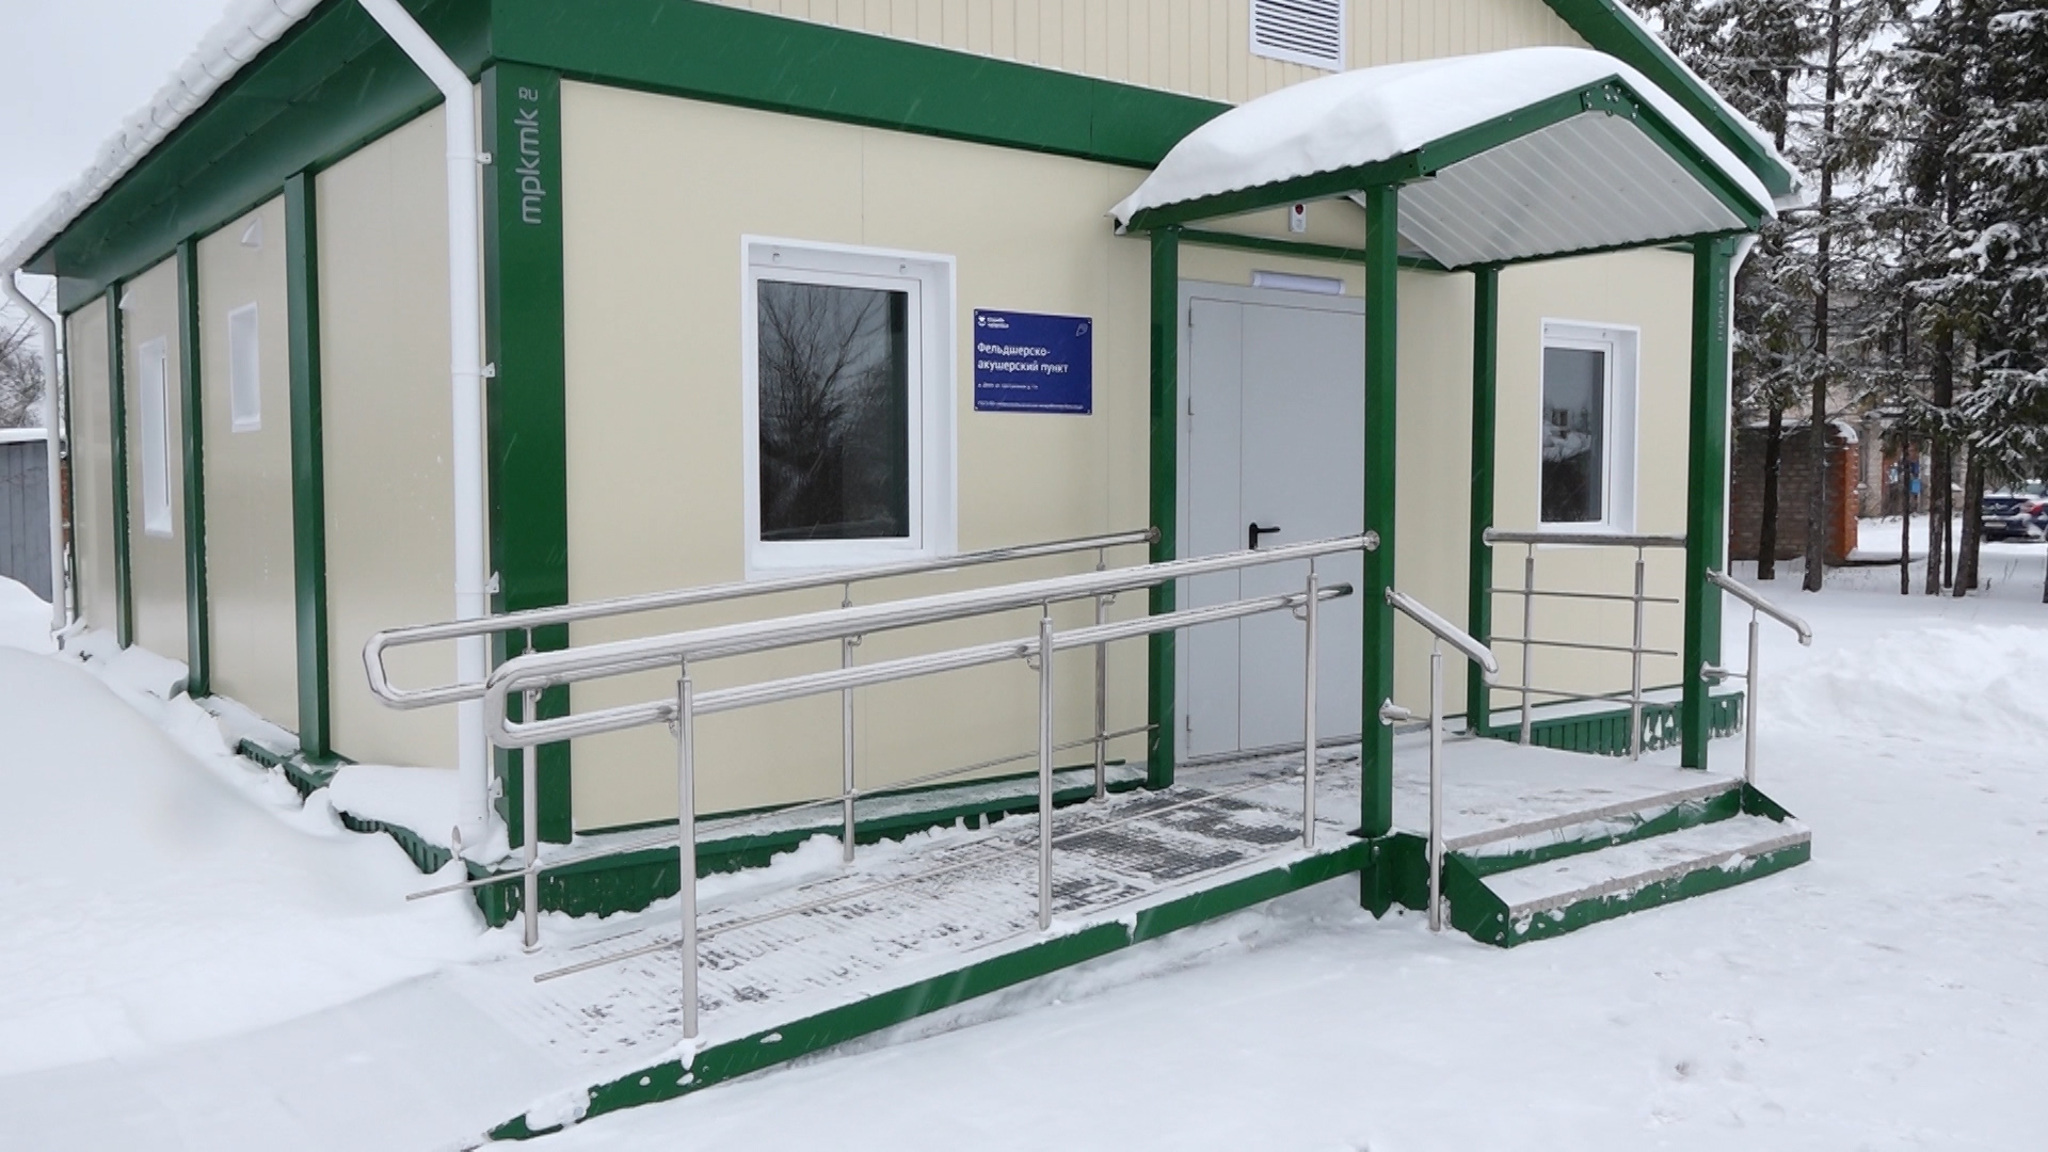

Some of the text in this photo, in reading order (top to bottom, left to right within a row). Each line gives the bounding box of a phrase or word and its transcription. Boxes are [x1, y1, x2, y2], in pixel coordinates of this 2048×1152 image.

[514, 87, 546, 224] mpkmk RU
[977, 342, 1051, 358] Фельдшерско-
[977, 360, 1069, 375] акушерский пункт
